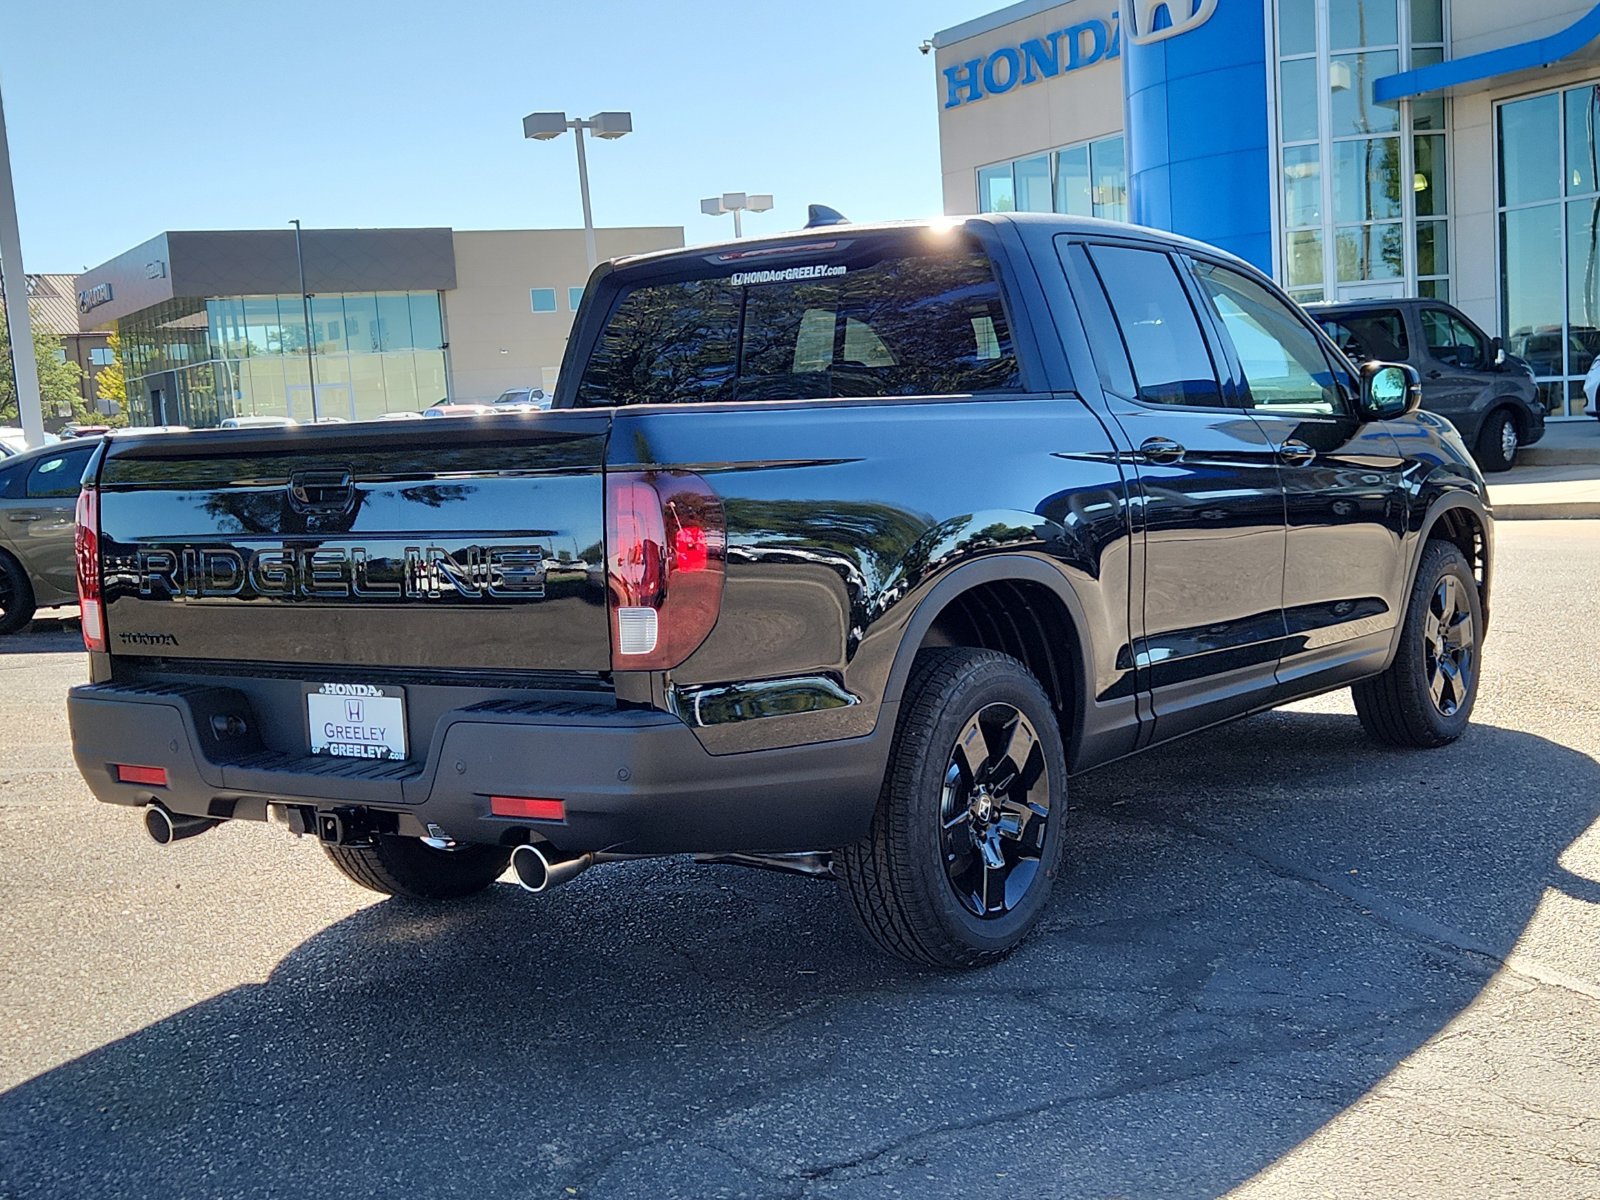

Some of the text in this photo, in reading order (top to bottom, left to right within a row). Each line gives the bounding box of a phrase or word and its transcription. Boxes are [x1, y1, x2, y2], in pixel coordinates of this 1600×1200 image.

[138, 544, 546, 599] RIDGELINE
[324, 683, 378, 696] HONDA
[324, 722, 386, 741] GREELEY
[330, 743, 382, 758] GREELEY
